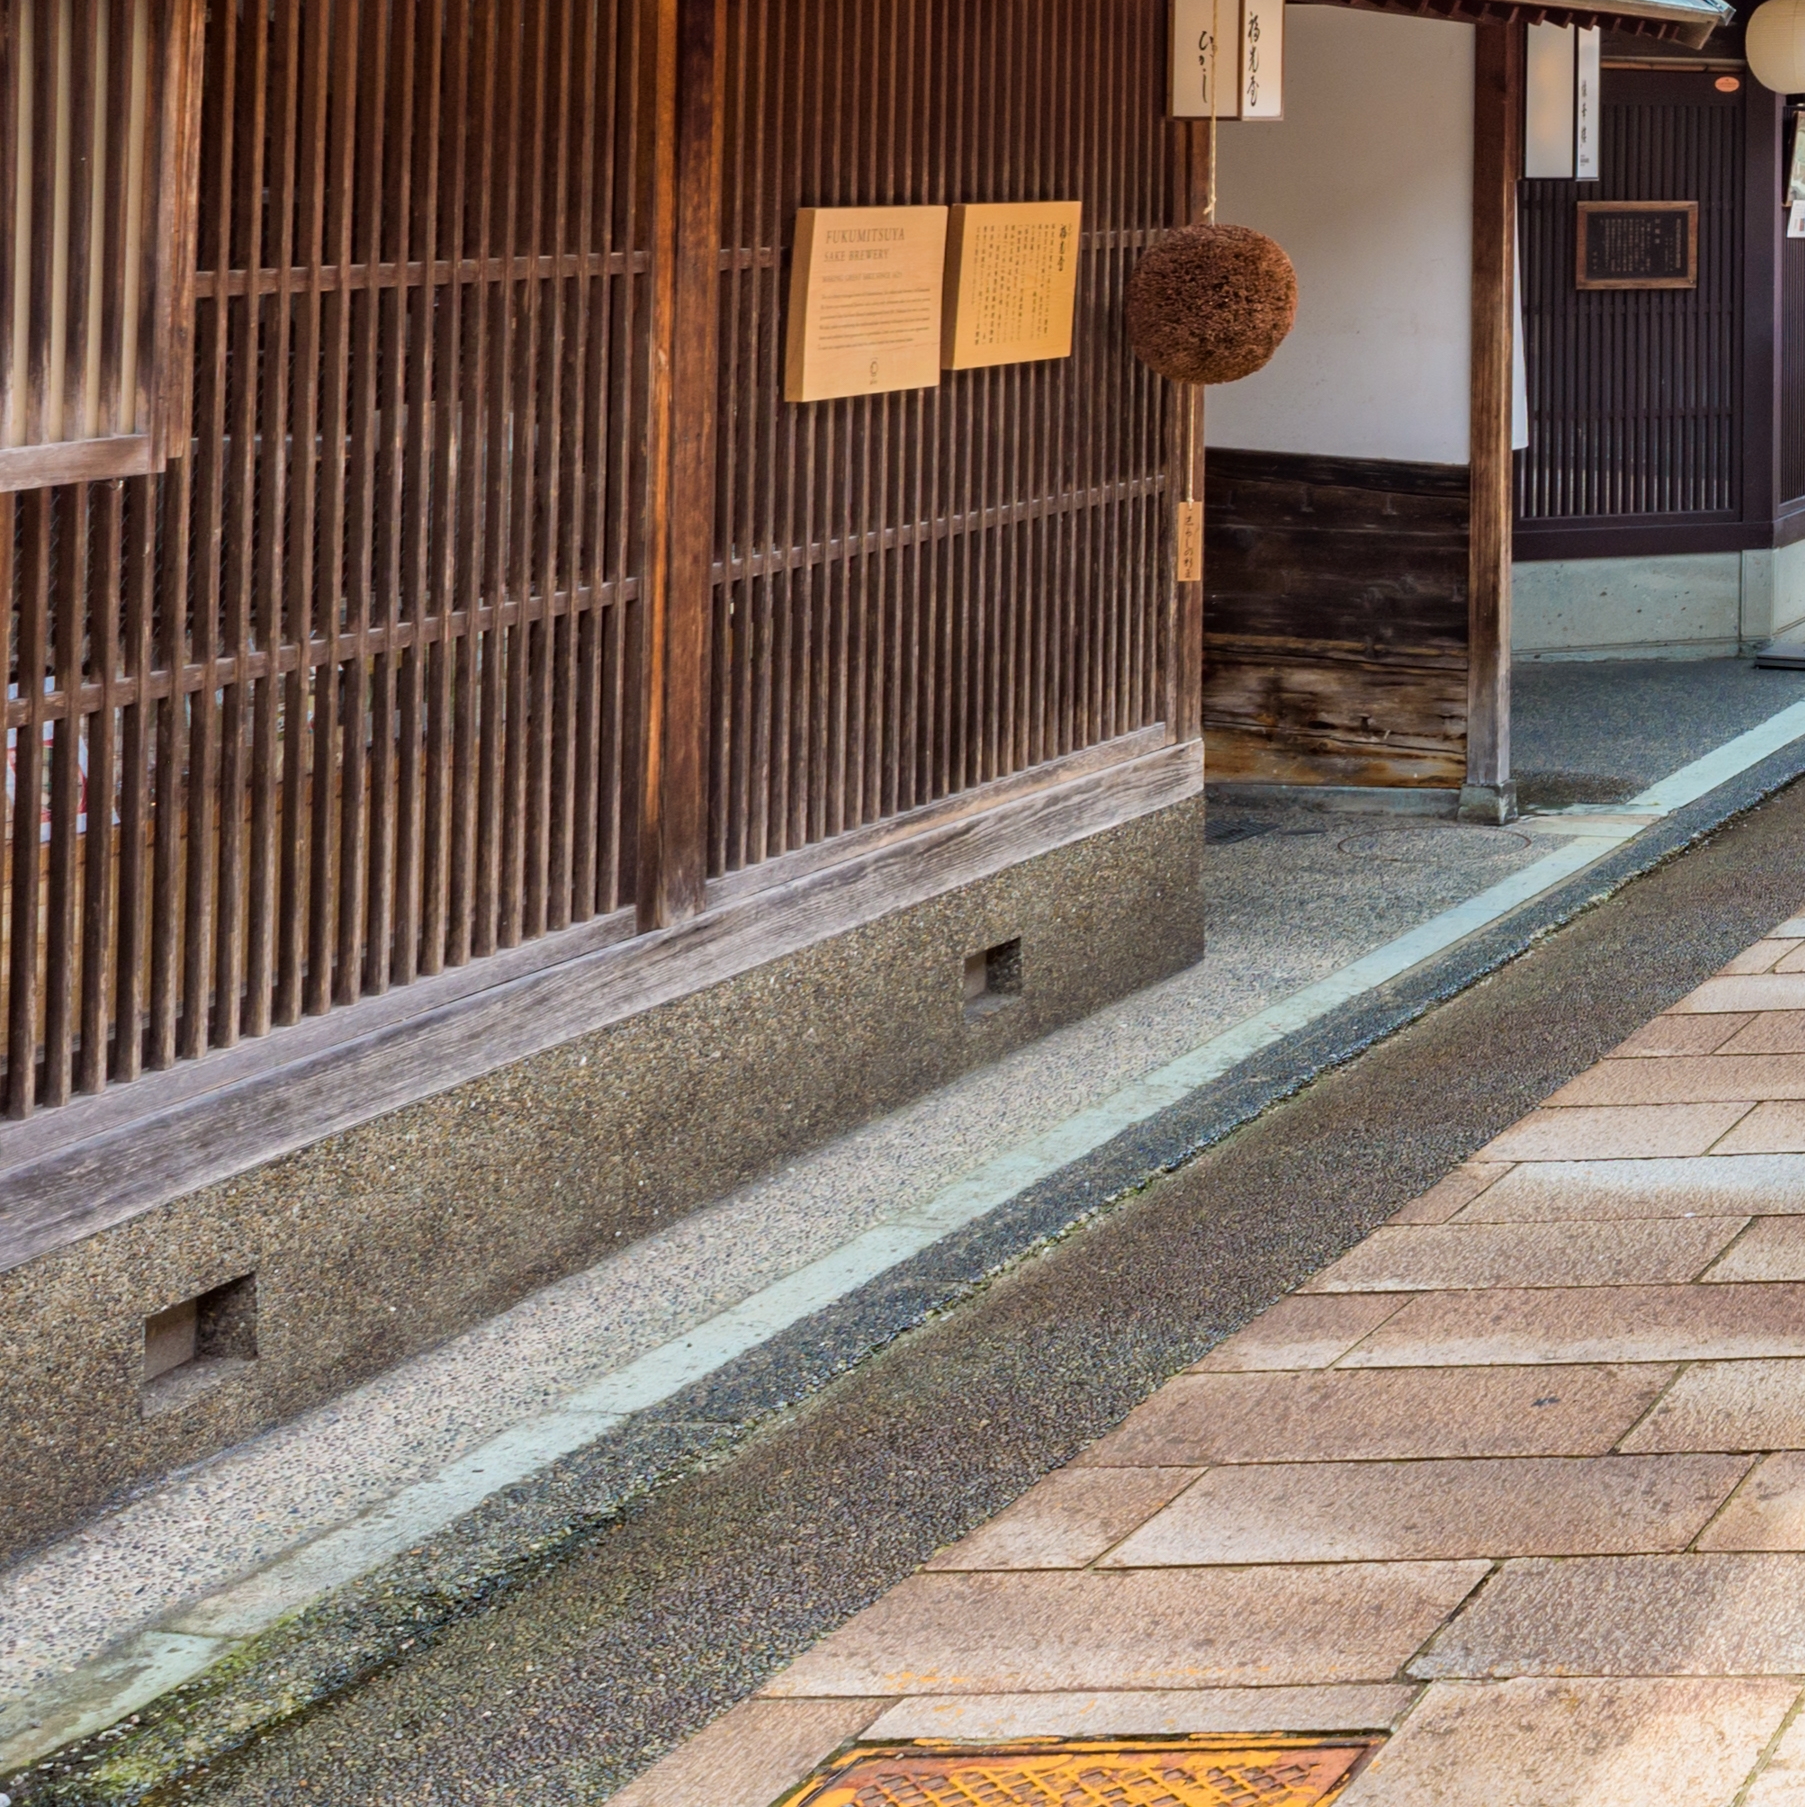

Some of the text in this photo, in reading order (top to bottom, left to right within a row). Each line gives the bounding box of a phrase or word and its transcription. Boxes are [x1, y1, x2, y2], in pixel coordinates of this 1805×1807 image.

[825, 227, 905, 244] FUKUMITSUYA
[823, 248, 890, 262] SAKE BREWERY
